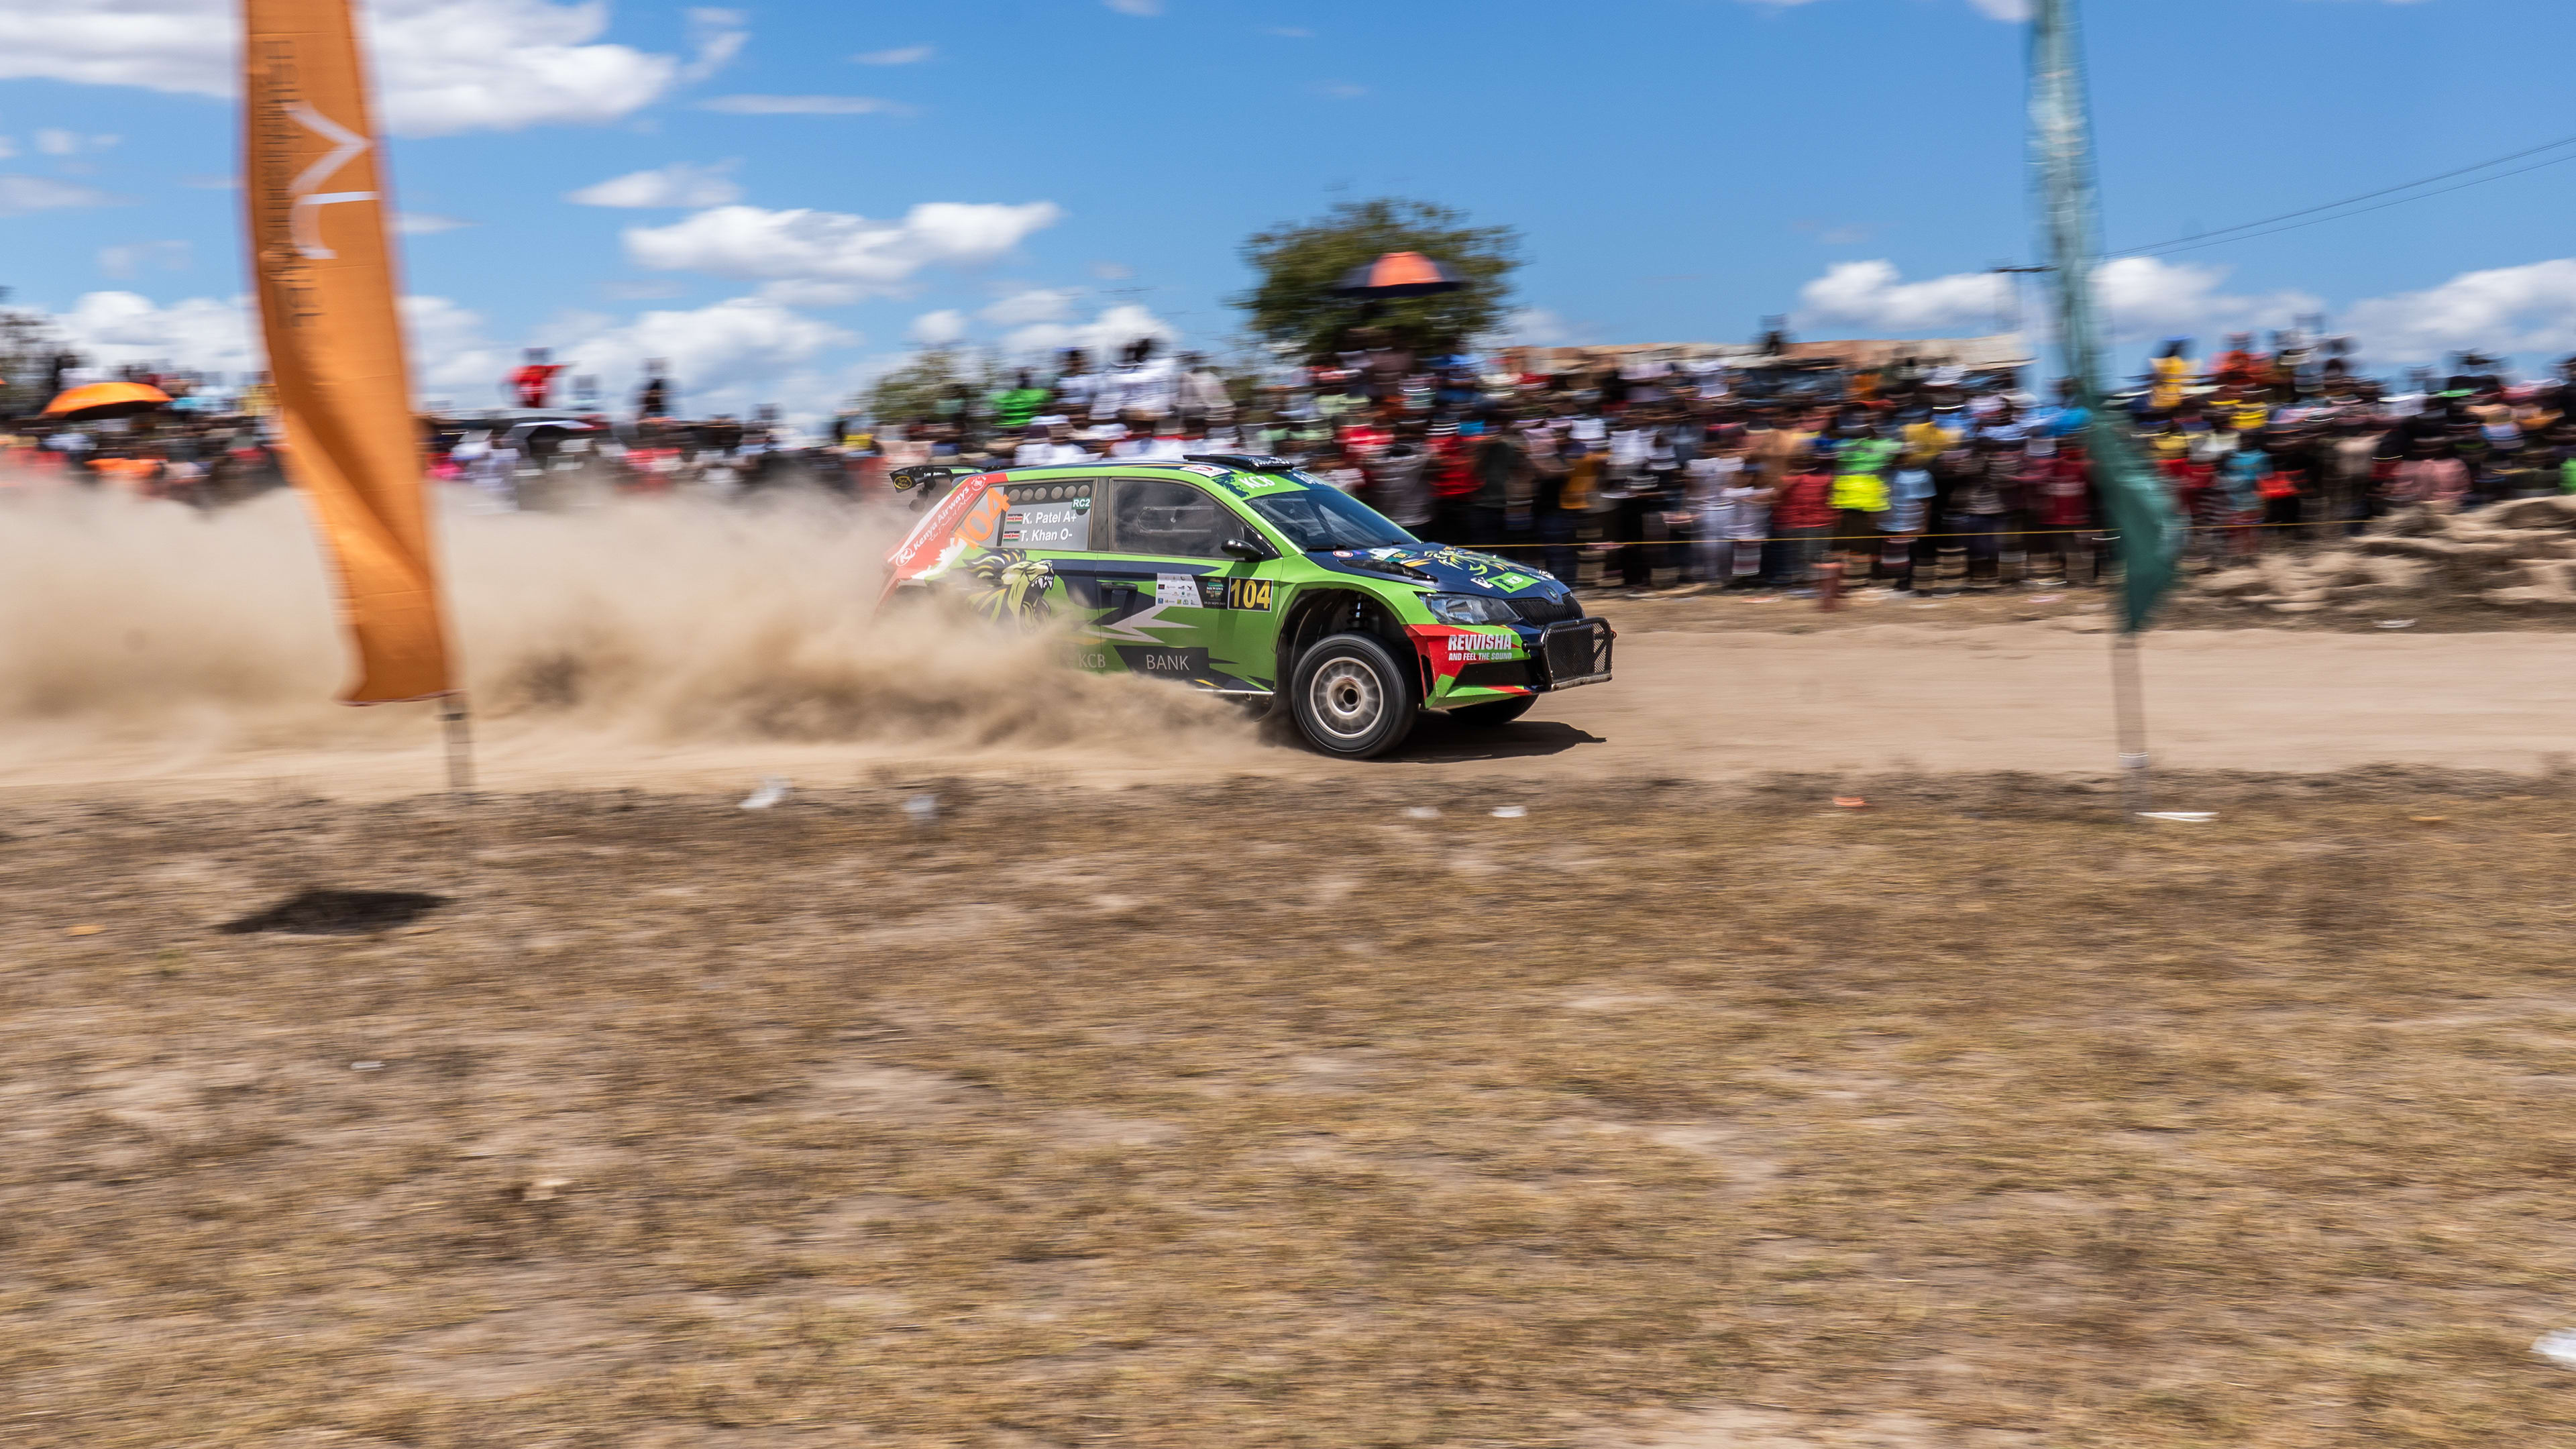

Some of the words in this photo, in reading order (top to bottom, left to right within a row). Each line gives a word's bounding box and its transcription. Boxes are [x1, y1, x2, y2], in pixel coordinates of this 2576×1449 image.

[1238, 476, 1275, 488] KCB
[1073, 498, 1091, 508] RC2
[913, 523, 938, 551] Kenya
[937, 486, 970, 523] Airways
[954, 488, 1011, 550] 104
[1022, 513, 1032, 524] K.
[1035, 511, 1061, 523] Patel
[1063, 511, 1077, 523] A+
[1020, 529, 1028, 541] T.
[1031, 529, 1058, 541] Khan
[1061, 528, 1073, 541] O-
[1230, 579, 1271, 609] 104
[1078, 653, 1106, 668] KCB
[1146, 654, 1190, 671] BANK
[1448, 652, 1462, 661] AND
[1463, 652, 1477, 661] FEEL
[1478, 652, 1490, 661] THE
[1491, 652, 1512, 660] SOUND
